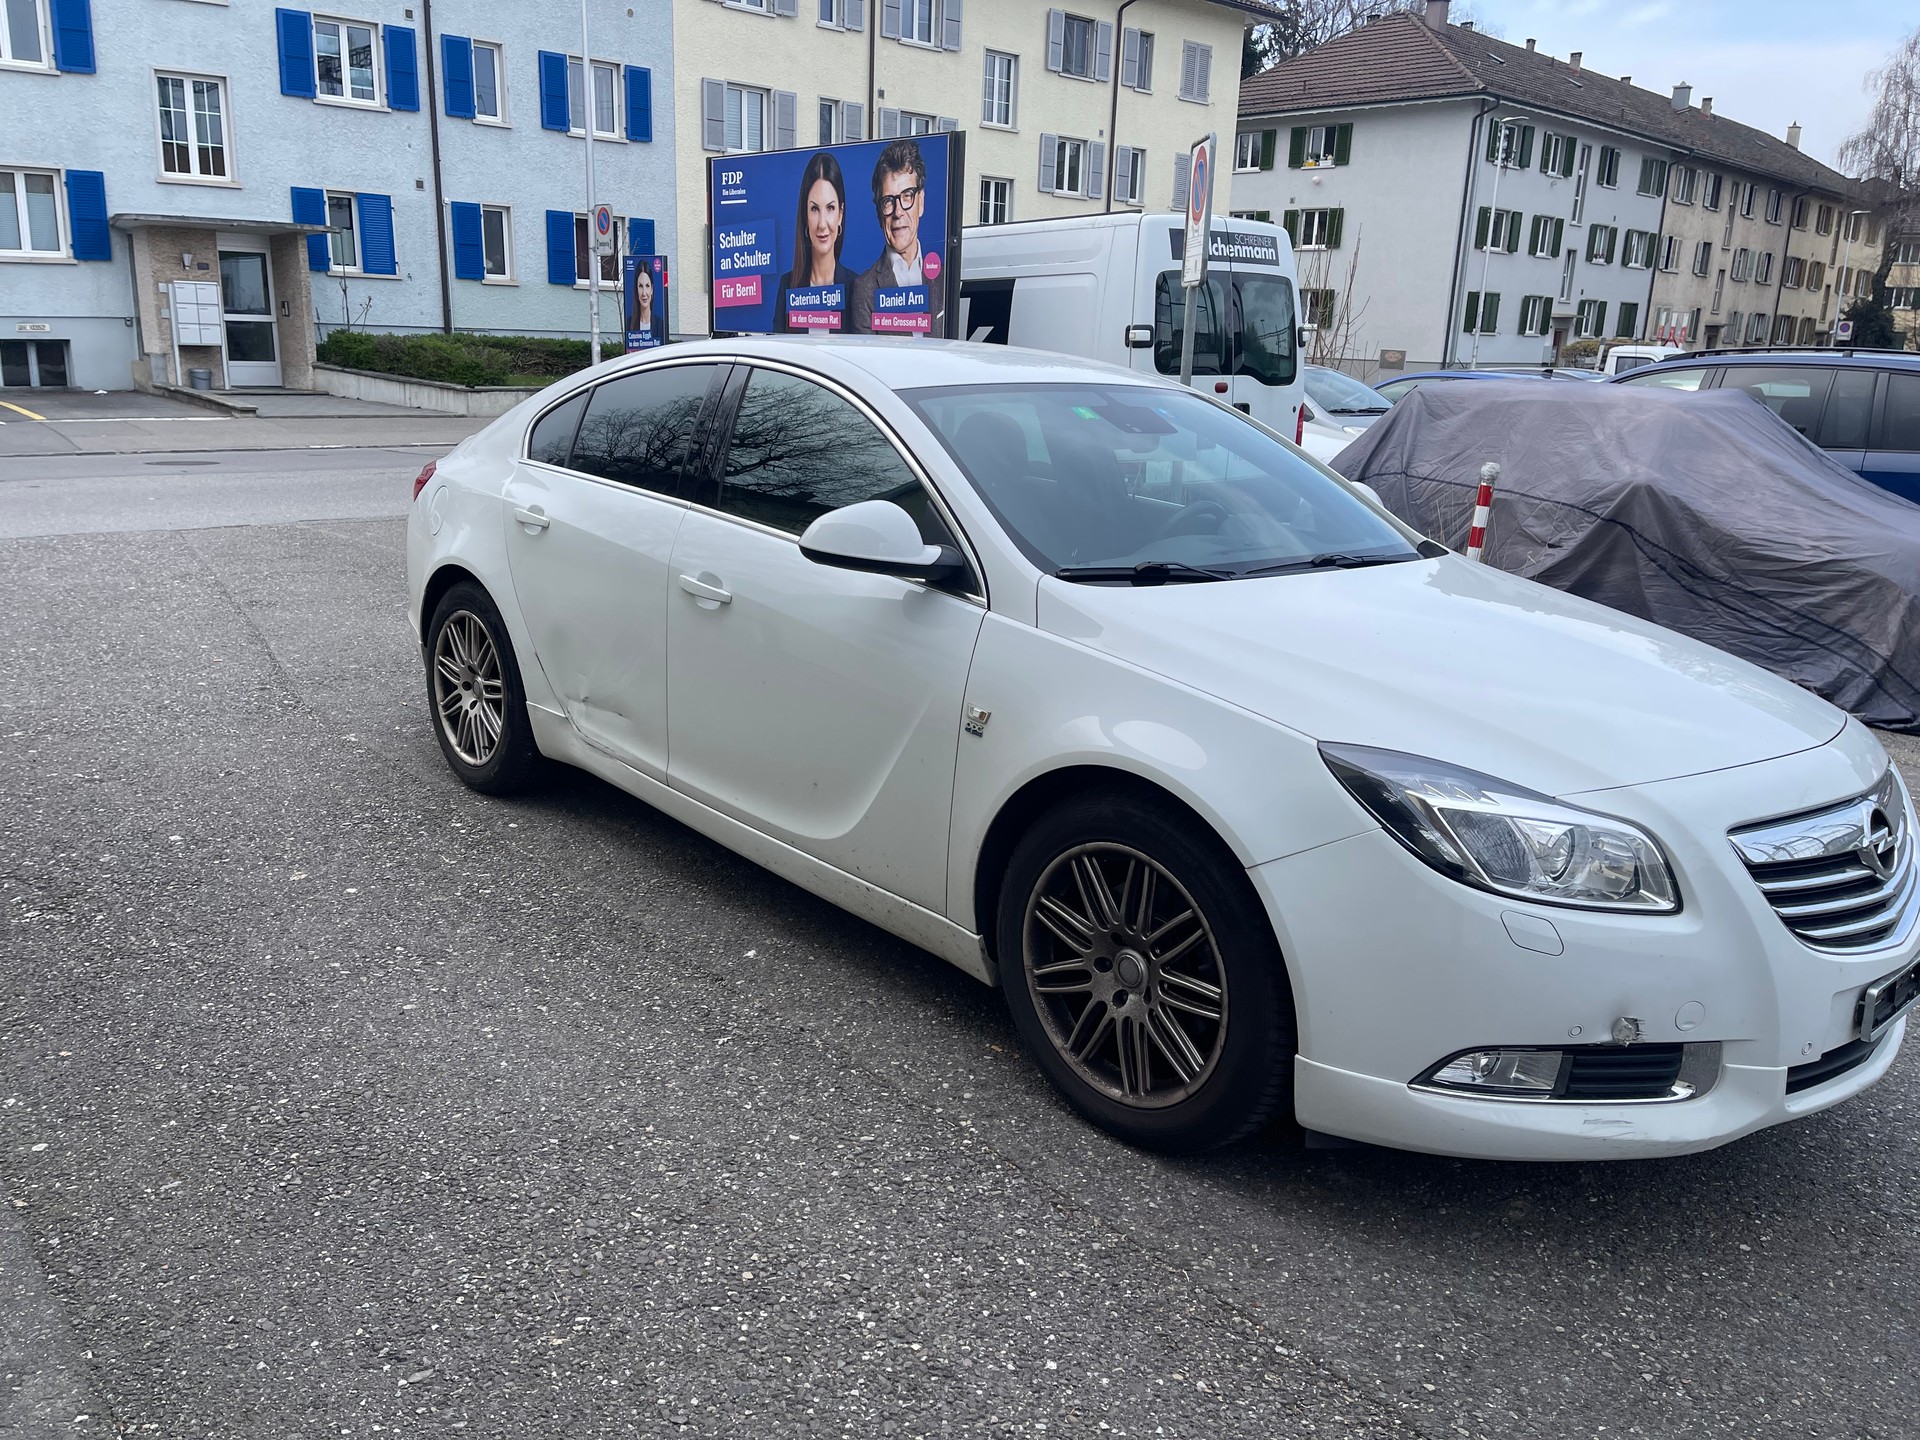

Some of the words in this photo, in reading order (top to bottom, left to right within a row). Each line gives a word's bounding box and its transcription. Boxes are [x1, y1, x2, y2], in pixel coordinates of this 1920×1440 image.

[721, 171, 743, 185] FDP
[719, 230, 756, 249] Schulter
[1234, 234, 1272, 247] SCHREINER
[720, 258, 732, 270] an
[733, 250, 771, 269] Schulter
[721, 284, 735, 298] Für
[736, 282, 756, 297] Bern!
[790, 292, 820, 306] Caterina
[822, 289, 841, 306] Eggli
[880, 292, 905, 307] Daniel
[908, 292, 924, 305] Arn
[791, 314, 797, 323] in
[797, 315, 807, 323] den
[808, 314, 829, 324] Grossen
[829, 315, 839, 325] Rat
[874, 316, 880, 326] in
[881, 316, 892, 326] den
[893, 316, 916, 327] Grossen
[917, 317, 928, 328] Rat
